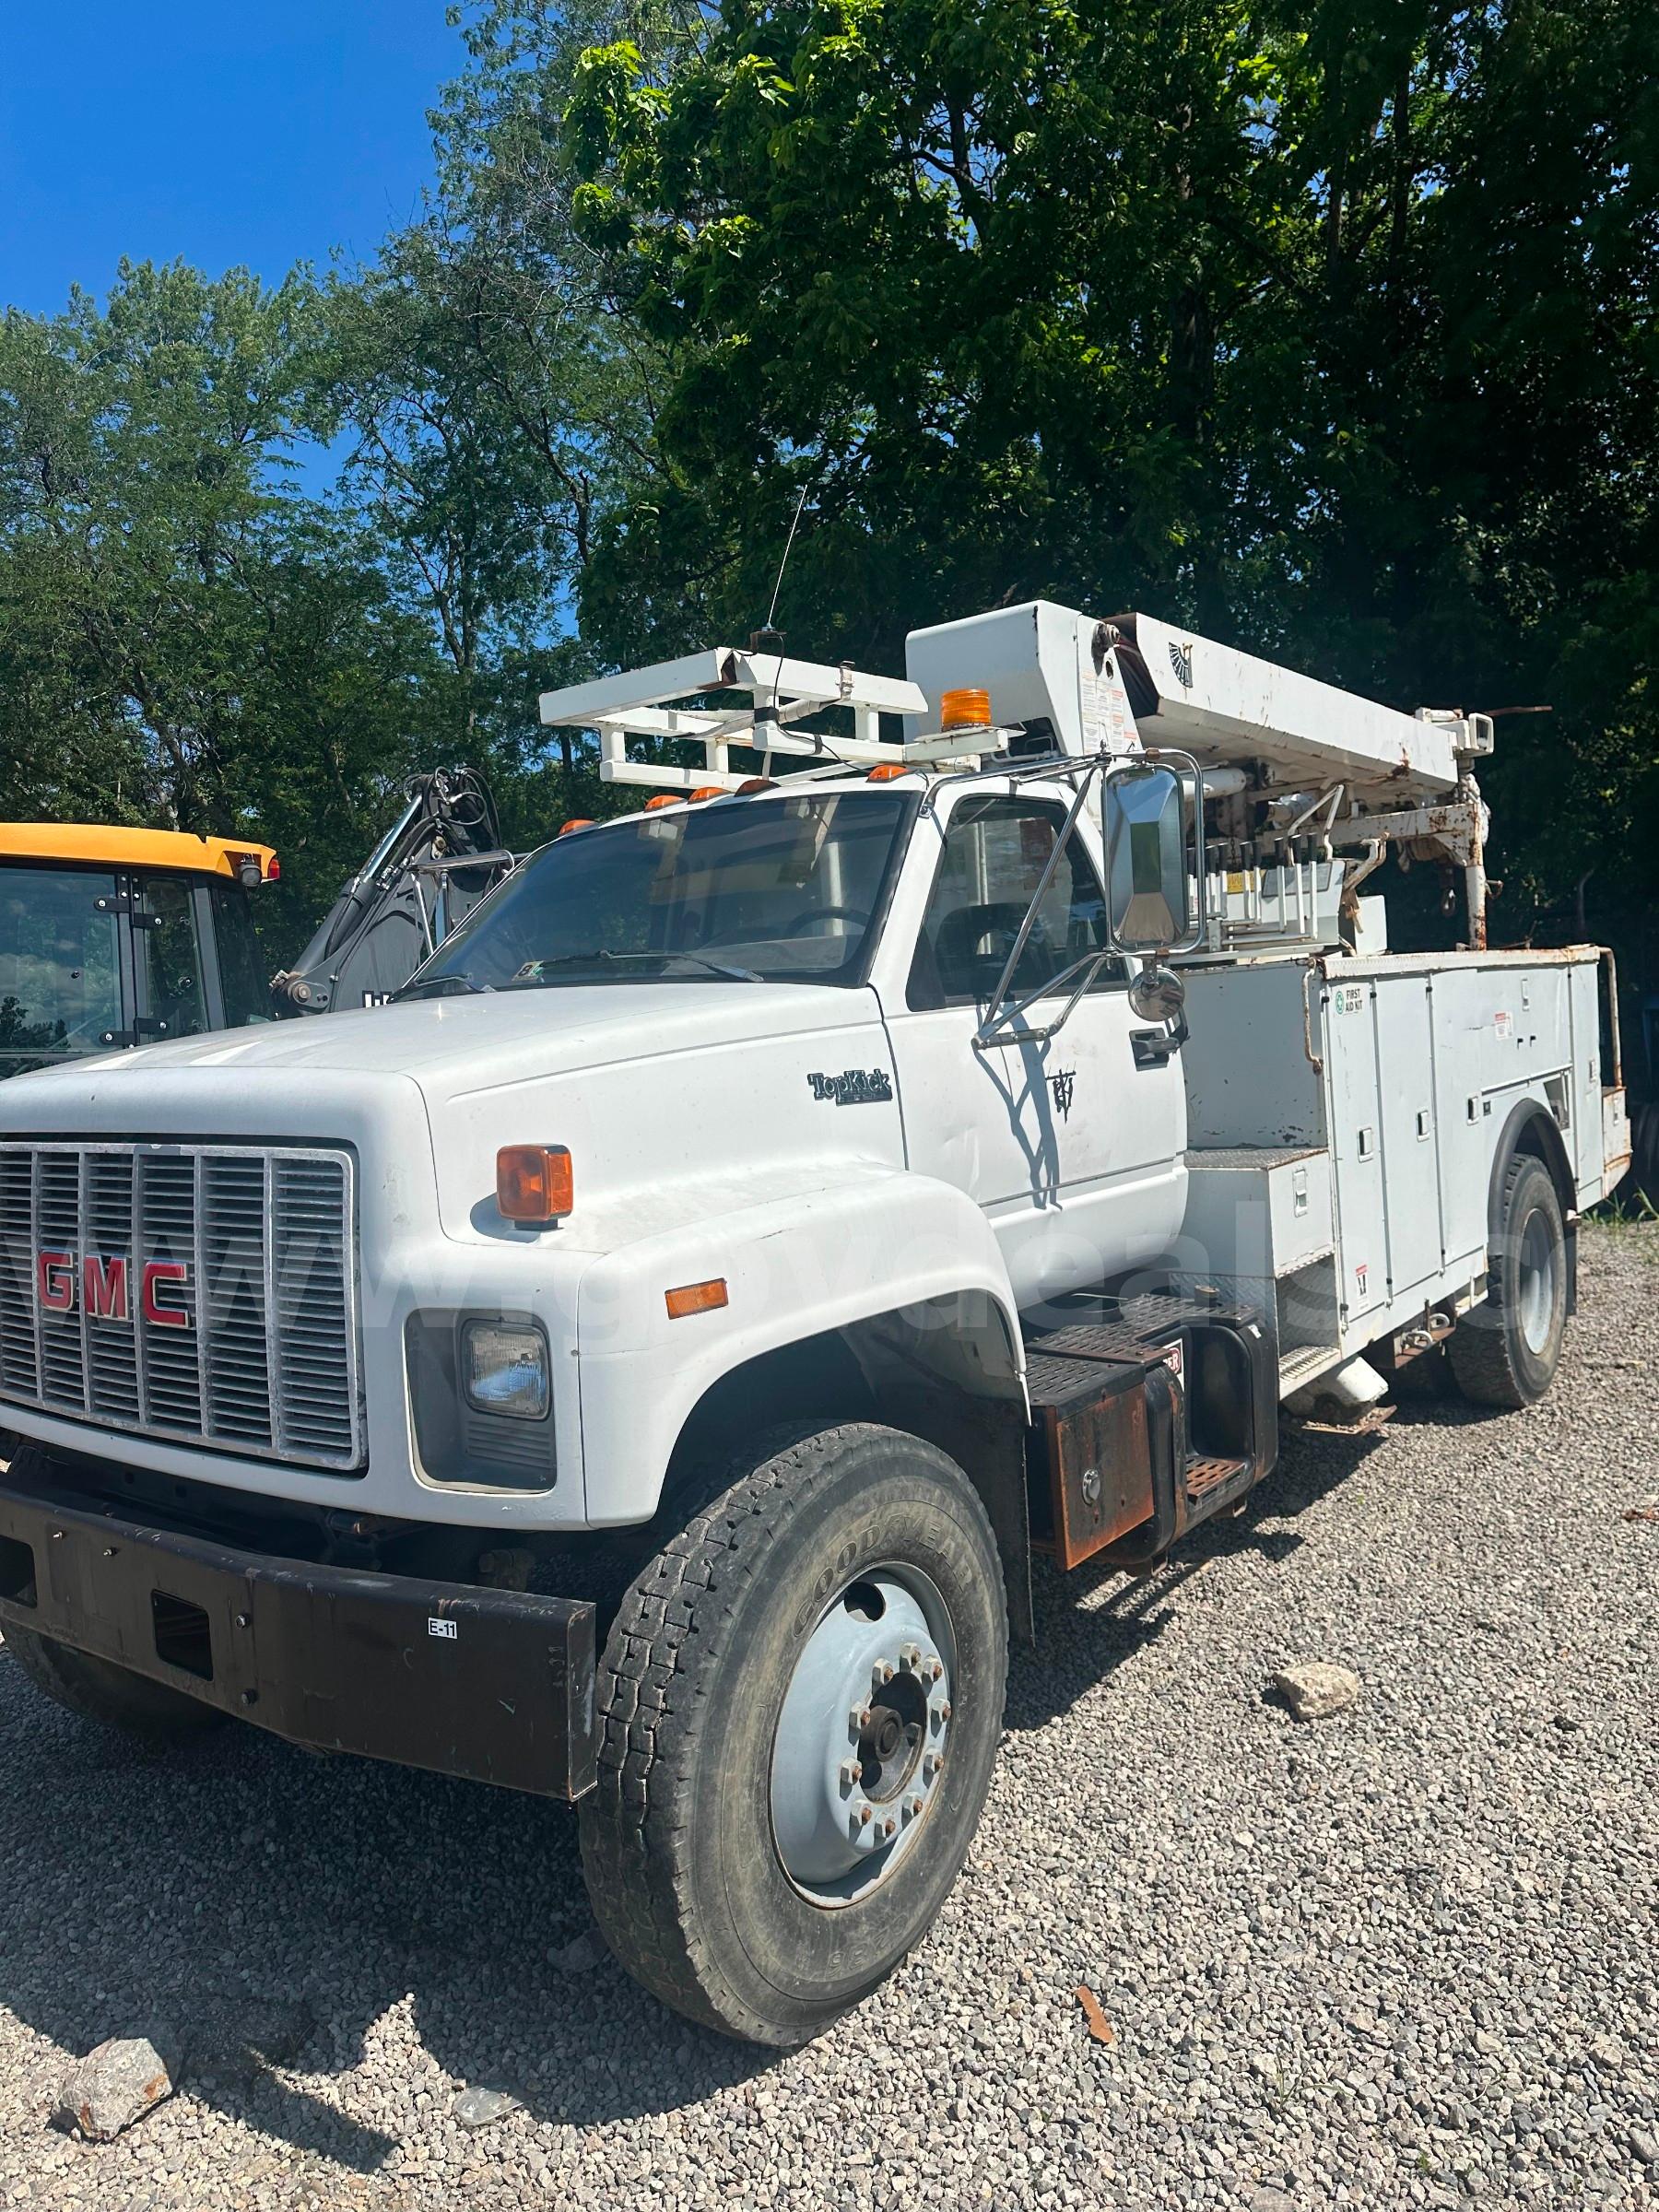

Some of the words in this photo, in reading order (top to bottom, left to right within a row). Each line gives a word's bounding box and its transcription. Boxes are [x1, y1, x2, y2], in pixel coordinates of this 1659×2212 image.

[1346, 988, 1360, 1000] FIRST
[1346, 1001, 1354, 1012] AID
[807, 1068, 892, 1105] TopKick
[38, 1247, 194, 1327] GMC
[793, 1512, 973, 1638] GOODYEAR
[429, 1619, 455, 1637] E-11
